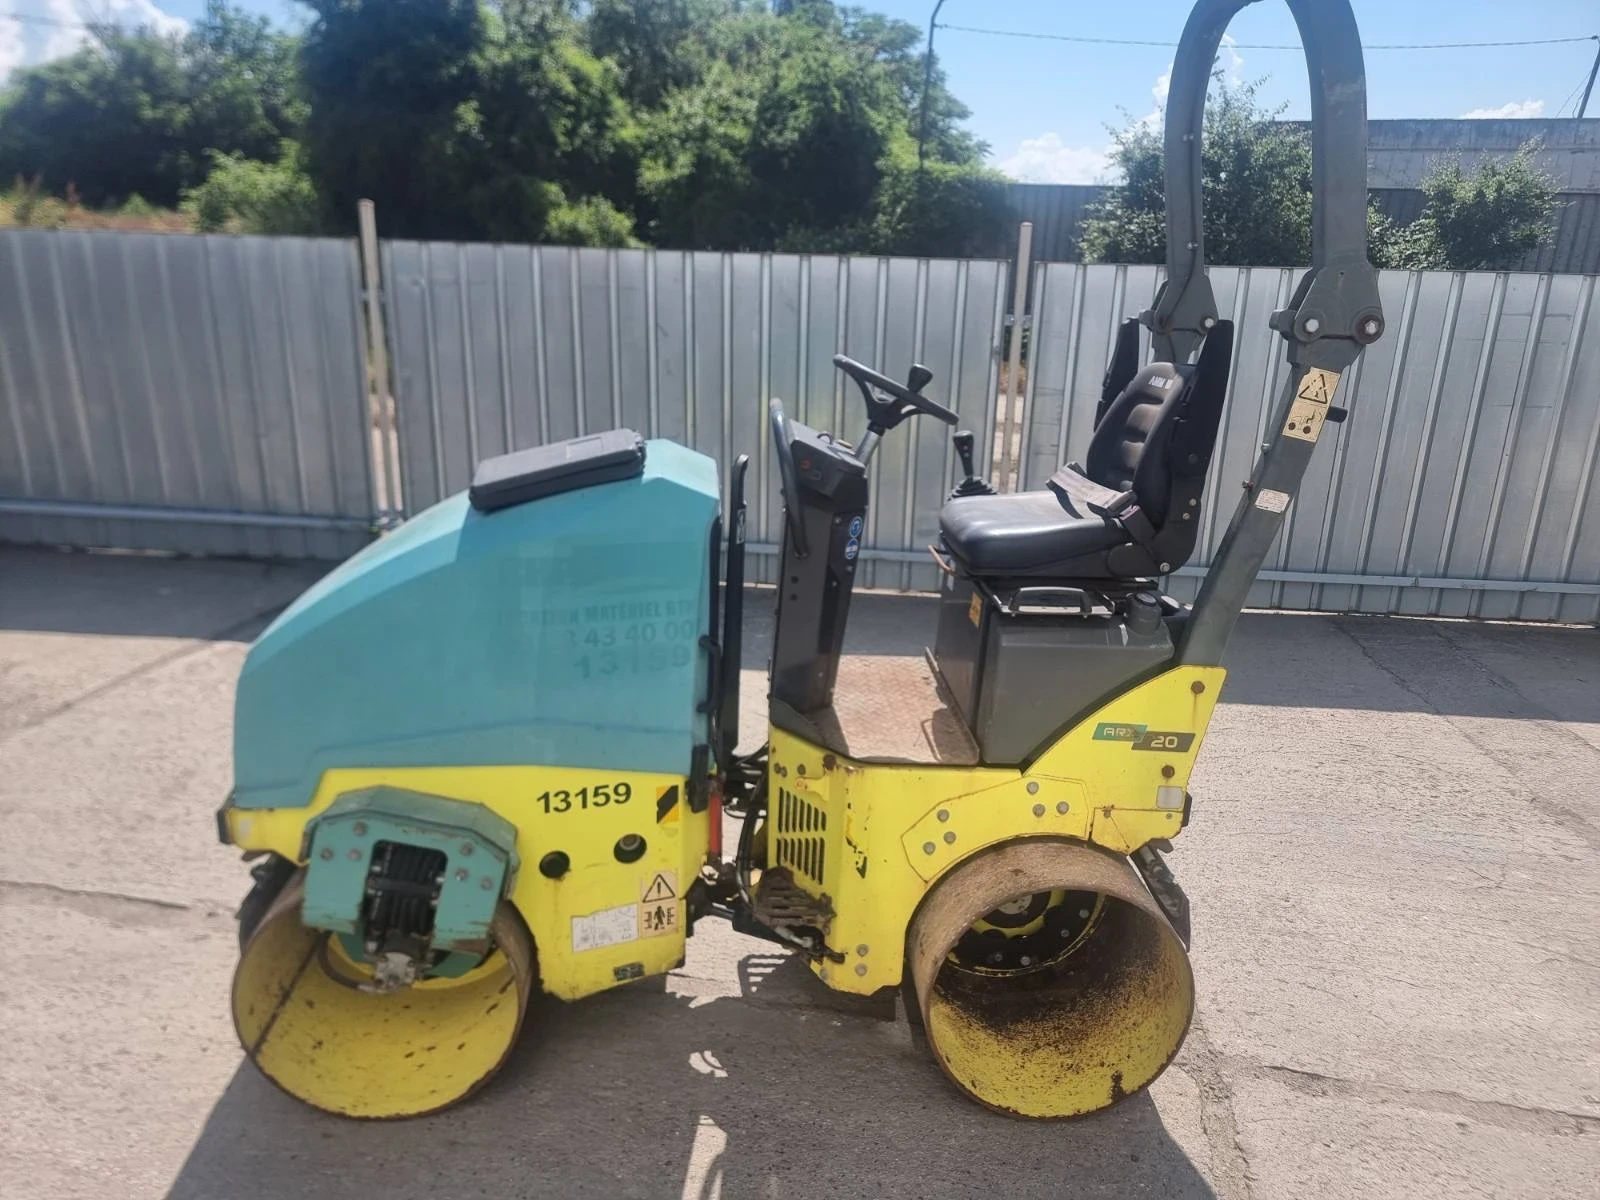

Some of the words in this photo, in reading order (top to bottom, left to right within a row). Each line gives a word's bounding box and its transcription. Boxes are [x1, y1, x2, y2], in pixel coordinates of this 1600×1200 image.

[584, 627, 616, 648] 43
[624, 622, 656, 642] 40
[664, 619, 695, 641] 00
[573, 643, 690, 679] 13159
[1151, 736, 1178, 748] 20
[537, 782, 632, 814] 13159
